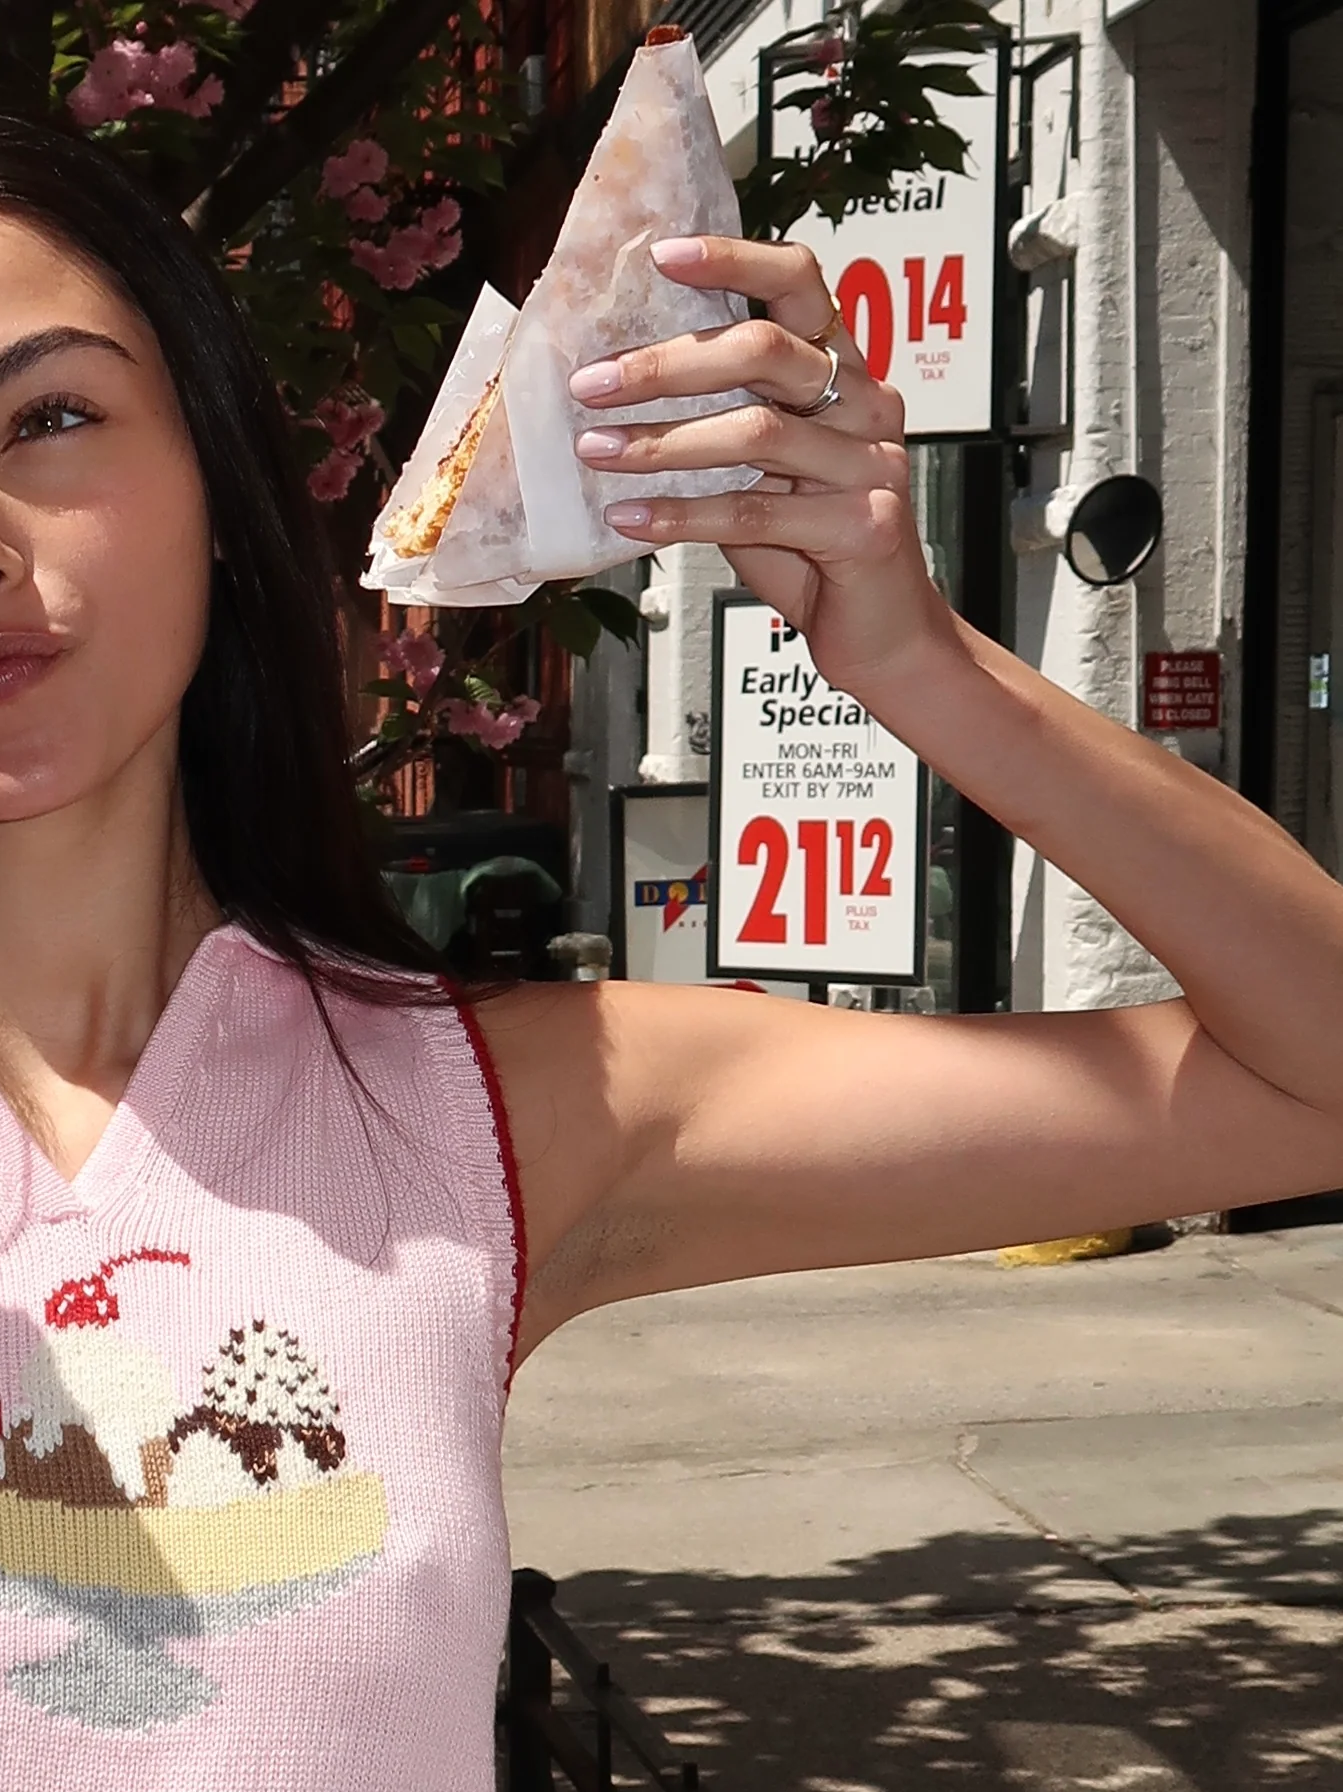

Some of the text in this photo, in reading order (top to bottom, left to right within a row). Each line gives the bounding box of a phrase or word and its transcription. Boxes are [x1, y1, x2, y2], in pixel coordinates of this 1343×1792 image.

[915, 352, 951, 365] PLUS
[920, 369, 946, 381] TAX
[1160, 660, 1205, 673] PLEASE
[741, 663, 819, 701] Early
[1165, 707, 1212, 720] CLOSED
[777, 742, 859, 760] MON-FRI
[741, 762, 896, 779] ENTER 6AM-9AM
[761, 781, 874, 799] EXIT BY 7PM
[845, 905, 878, 918] PLUS
[847, 919, 870, 931] TAX
